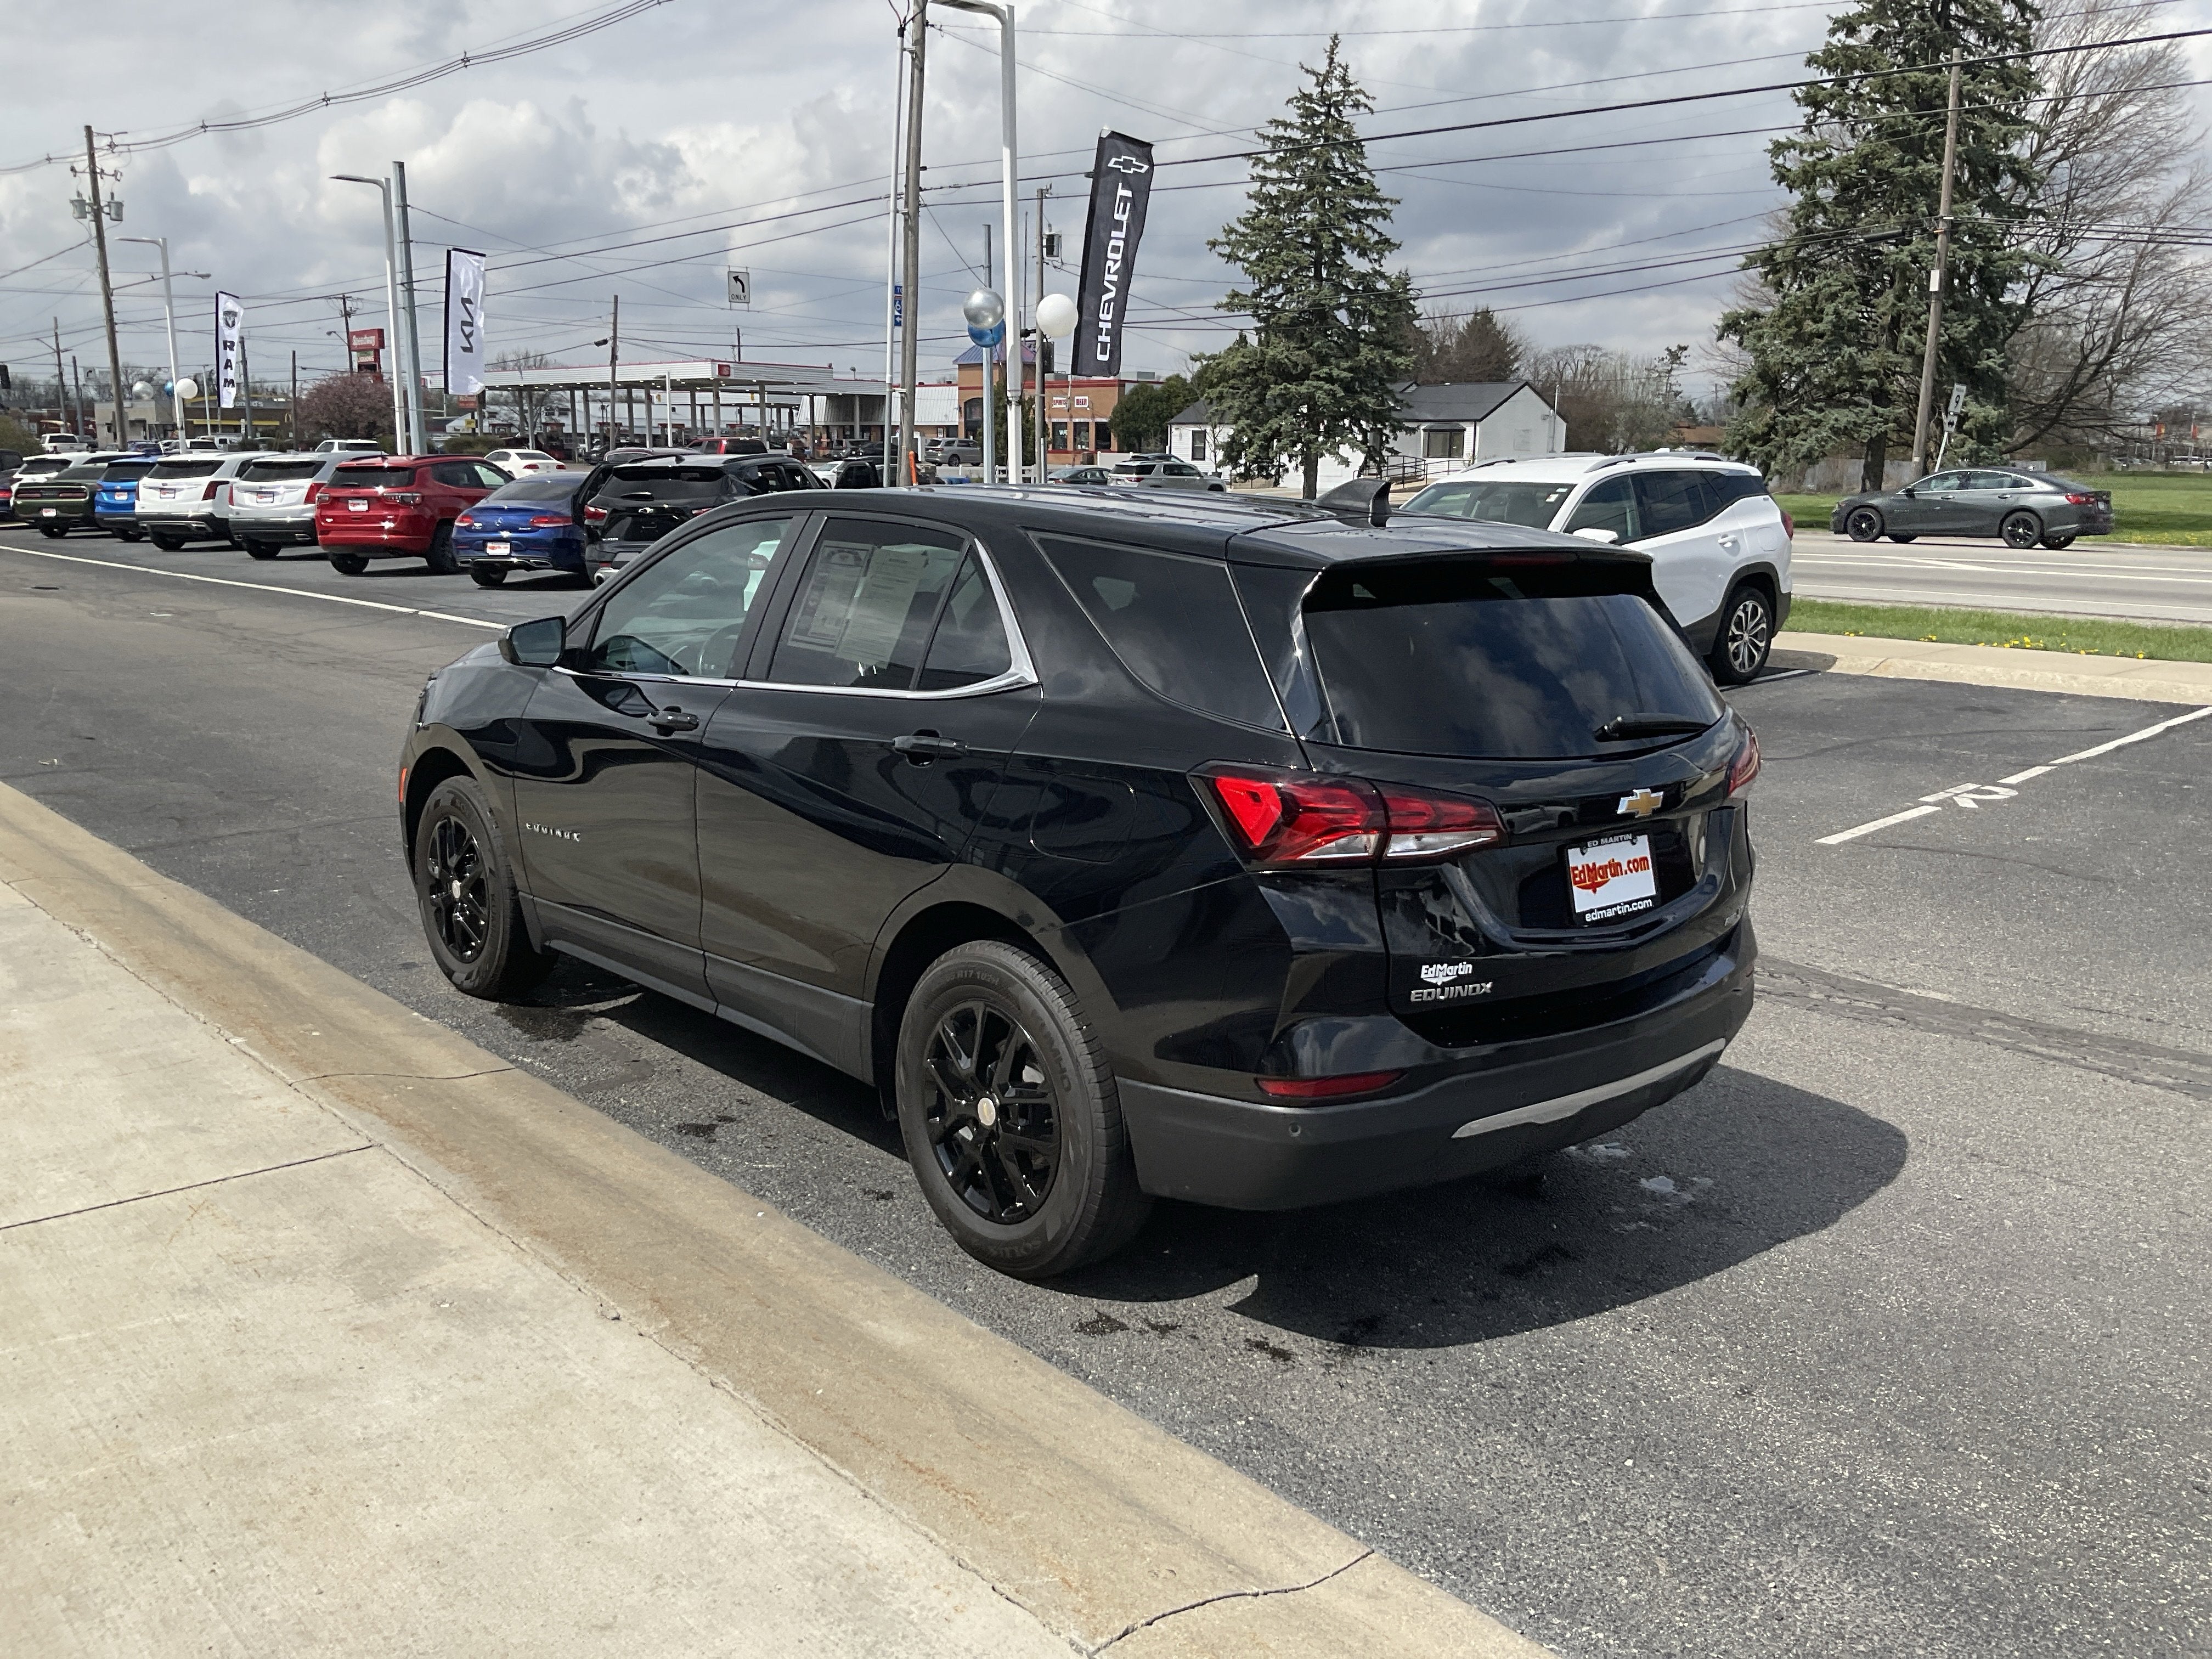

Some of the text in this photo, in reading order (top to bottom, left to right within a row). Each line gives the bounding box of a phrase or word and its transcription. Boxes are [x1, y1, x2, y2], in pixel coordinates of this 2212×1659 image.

[1097, 183, 1132, 362] CHEVROLET
[460, 297, 474, 353] KIA
[222, 340, 235, 388] RAM
[1600, 833, 1632, 845] MARTIN
[1570, 856, 1650, 886] EdMartin.com
[1585, 898, 1652, 922] edmartin.com
[1420, 961, 1473, 979] EdMartin
[1410, 981, 1493, 1002] EQUINOX
